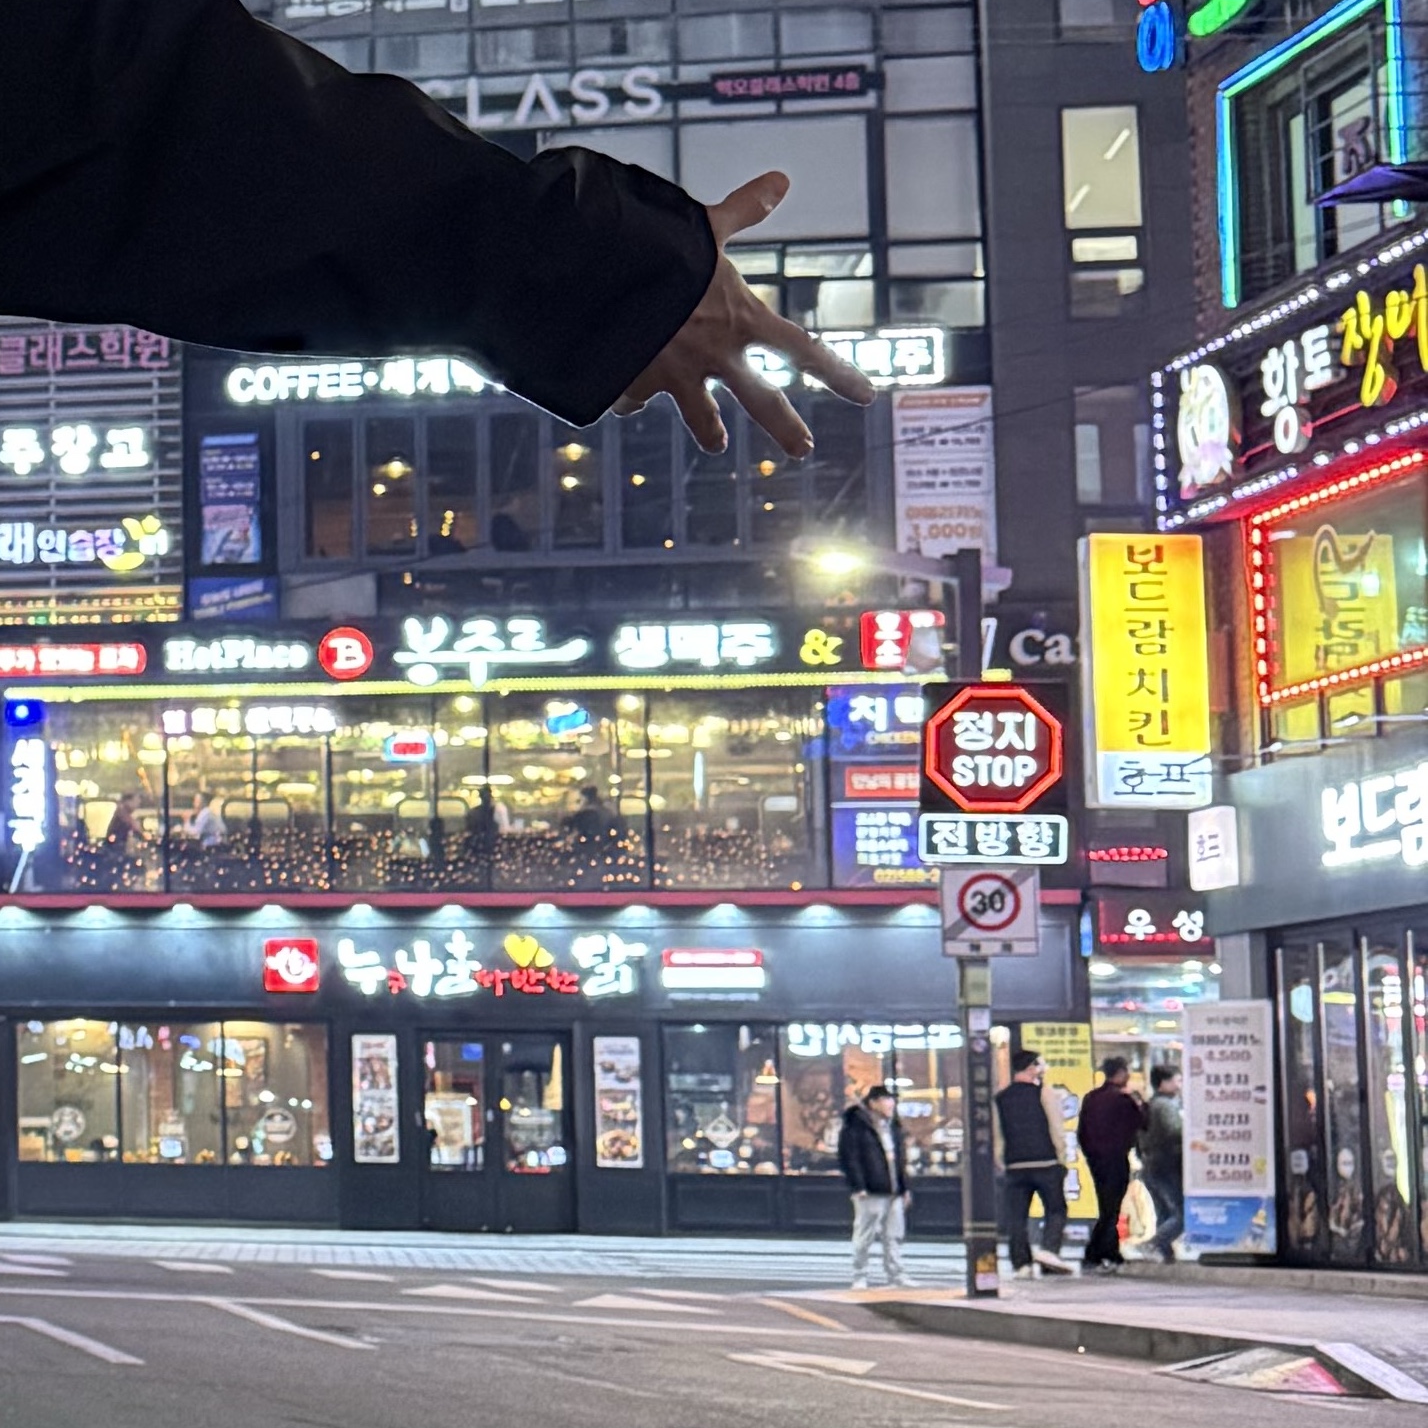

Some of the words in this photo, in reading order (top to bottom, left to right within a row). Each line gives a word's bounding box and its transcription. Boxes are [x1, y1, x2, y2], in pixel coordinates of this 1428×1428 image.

[1123, 544, 1175, 747] 보드람치킨
[952, 711, 1037, 752] 정지
[952, 754, 1038, 788] STOP
[931, 820, 1055, 858] 전방향
[970, 890, 1006, 916] 30
